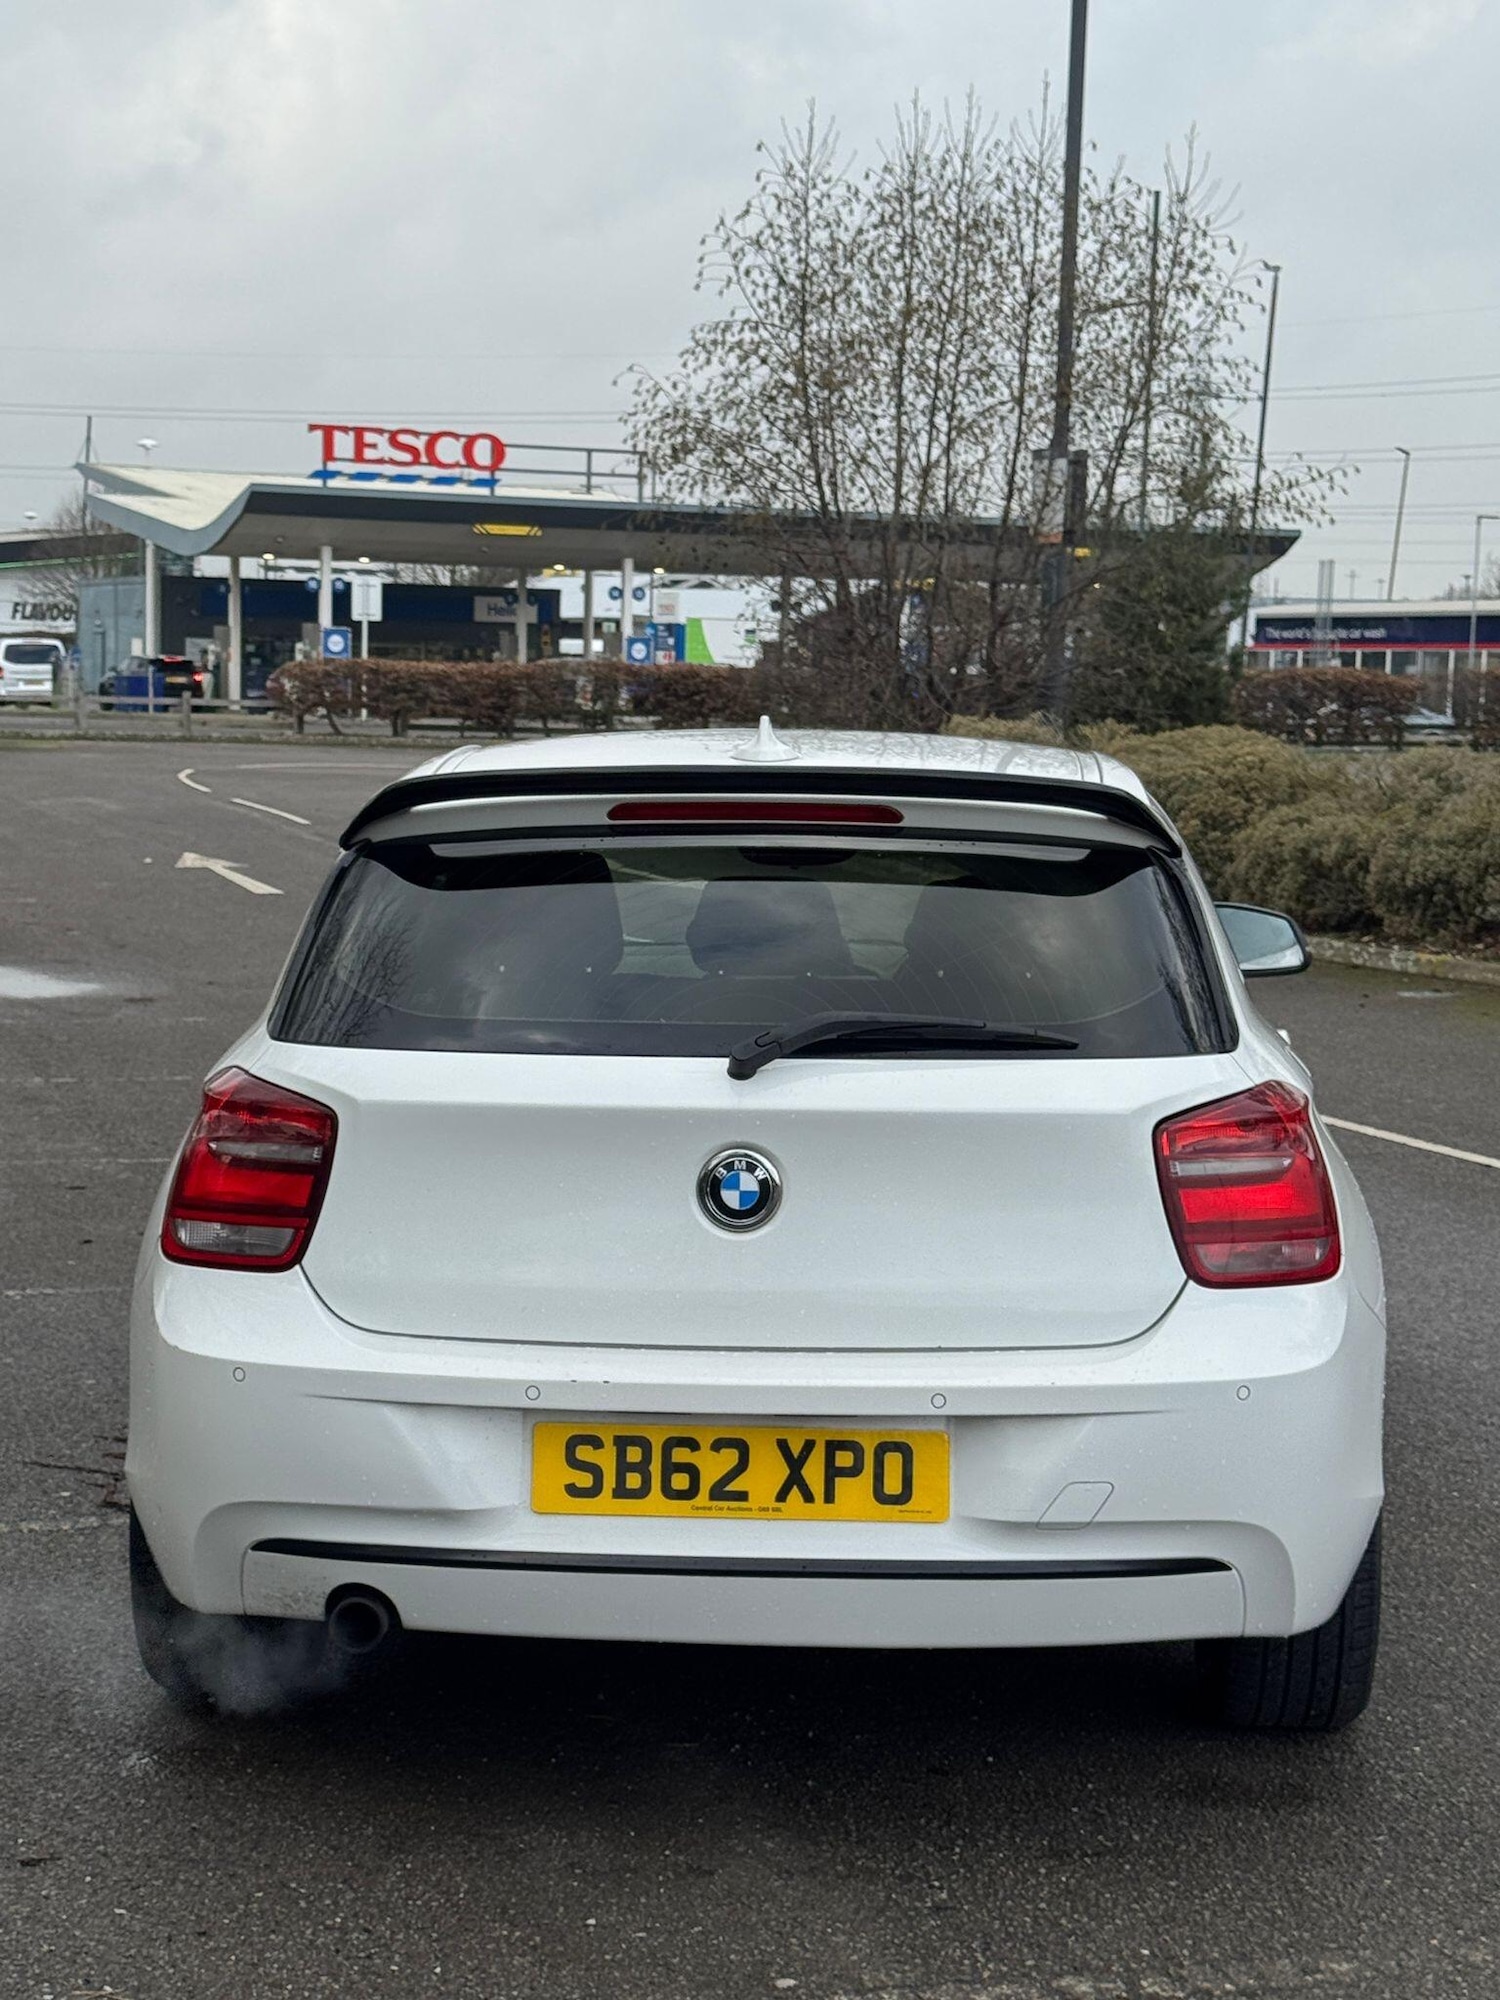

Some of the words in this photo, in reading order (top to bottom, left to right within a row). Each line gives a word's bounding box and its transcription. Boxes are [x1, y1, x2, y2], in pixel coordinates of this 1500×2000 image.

[308, 424, 506, 472] TESCO
[715, 1160, 768, 1180] BMW
[564, 1434, 750, 1502] SB62
[774, 1438, 914, 1506] XPO
